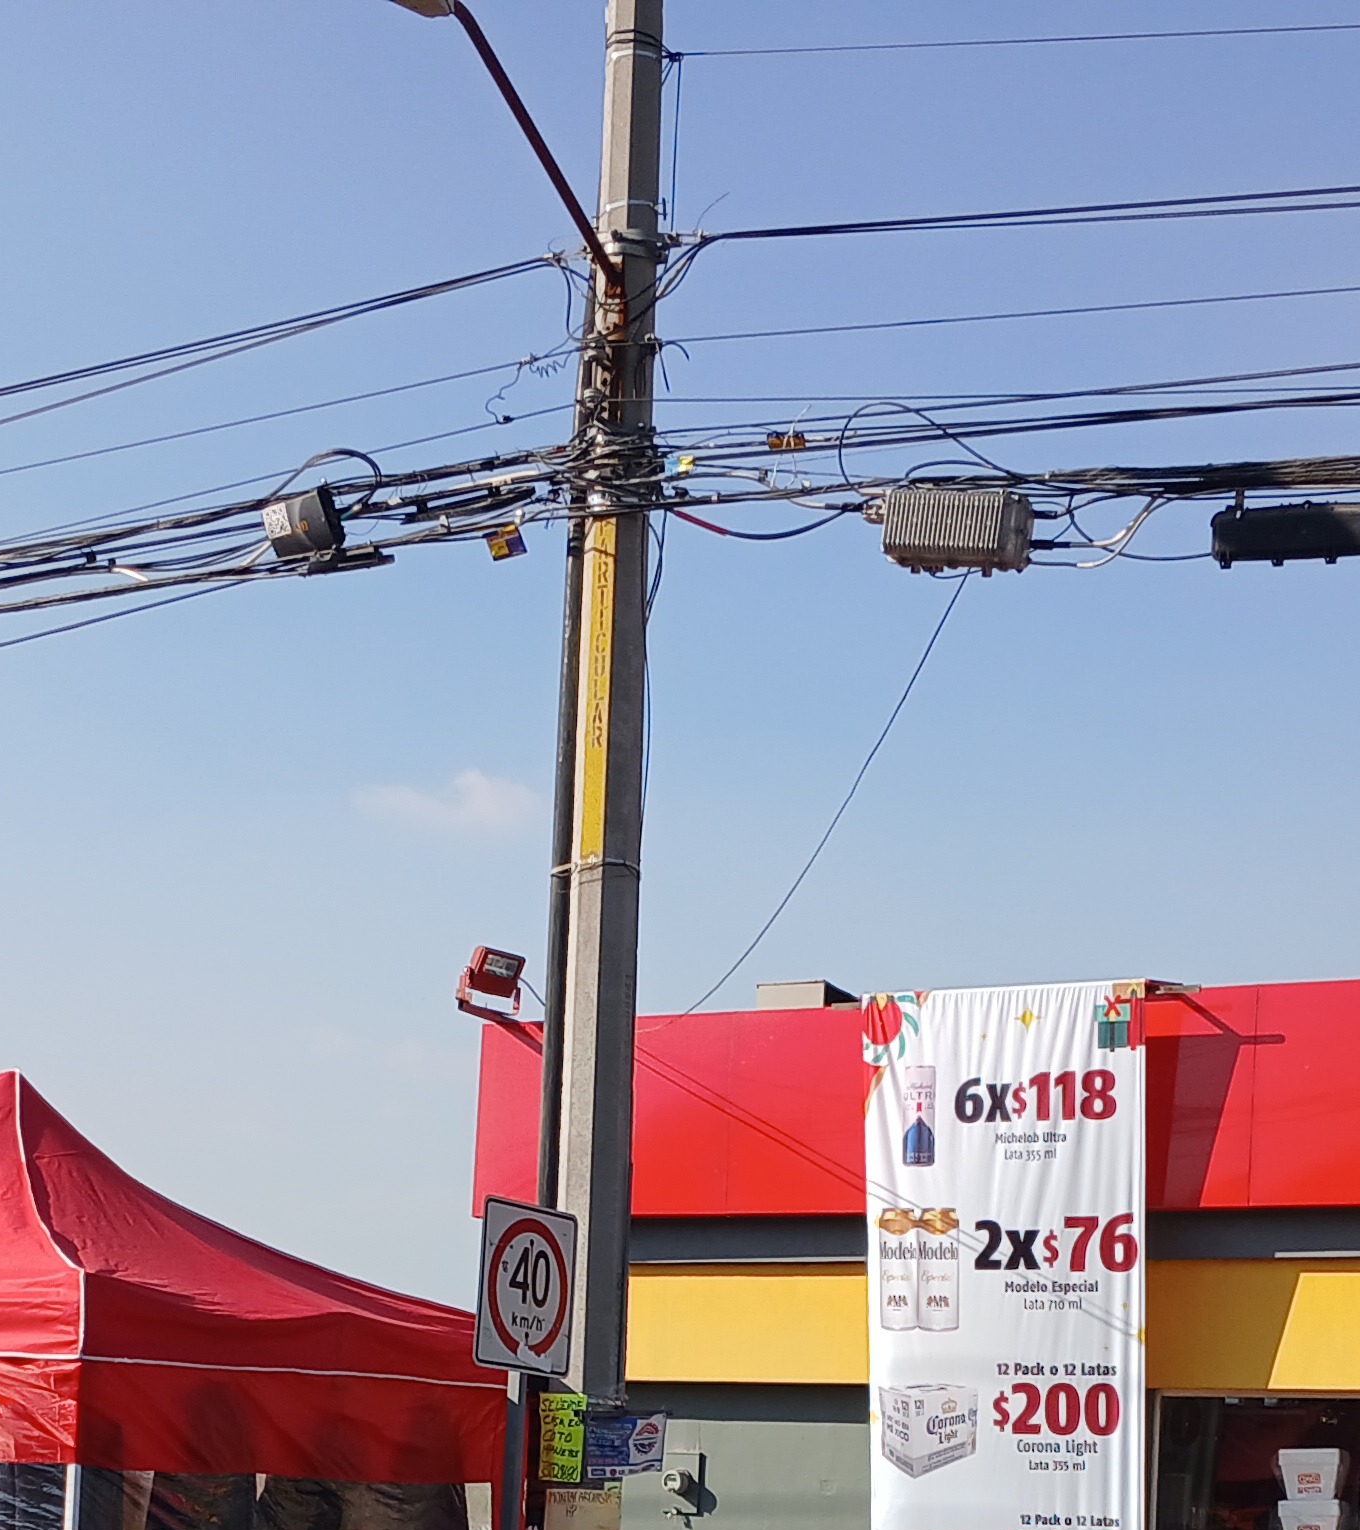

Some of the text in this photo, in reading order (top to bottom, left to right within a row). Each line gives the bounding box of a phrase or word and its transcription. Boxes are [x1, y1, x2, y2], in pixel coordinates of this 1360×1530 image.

[995, 1131, 1067, 1144] Michelob Ultra
[1004, 1148, 1056, 1162] Lata 355 ml
[509, 1246, 551, 1309] 40
[1005, 1280, 1099, 1295] Modelo Especial
[1024, 1298, 1082, 1312] Lata 710 ml
[511, 1311, 545, 1332] km/h
[997, 1362, 1117, 1376] 12 Pack o 12 Latas
[993, 1382, 1120, 1436] $200
[926, 1413, 966, 1436] Corona
[1017, 1439, 1098, 1456] Corona Light
[1029, 1459, 1086, 1472] Lata 355 ml
[1020, 1513, 1120, 1527] 12 Pack o 12 Latas
